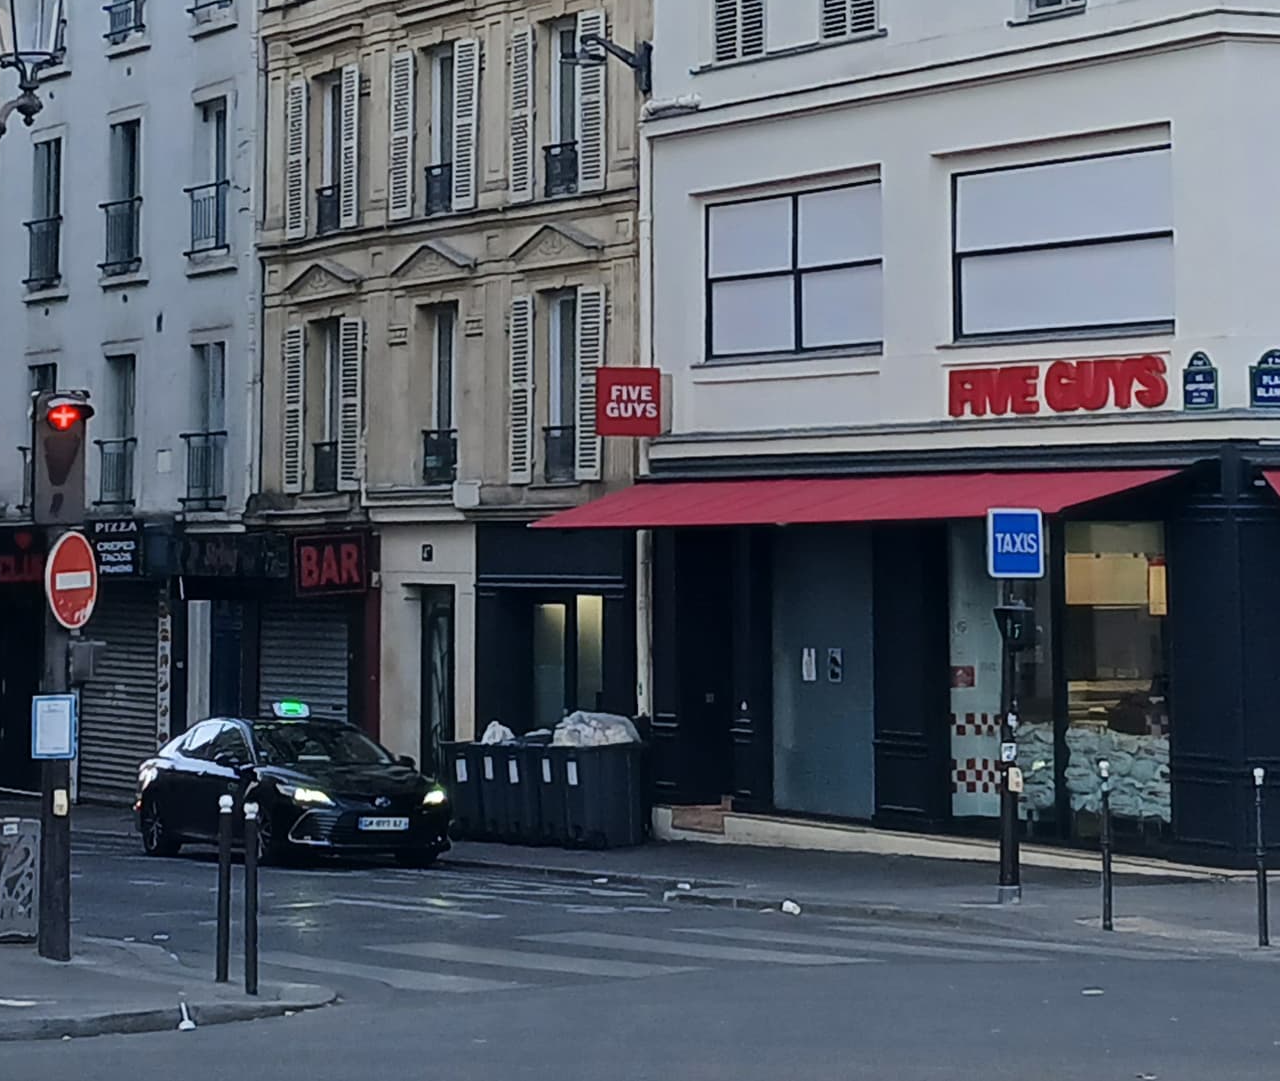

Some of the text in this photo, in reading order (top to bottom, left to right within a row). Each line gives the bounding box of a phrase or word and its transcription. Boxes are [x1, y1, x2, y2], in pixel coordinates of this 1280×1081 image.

[609, 384, 653, 402] FIVE
[948, 364, 1039, 417] FIVE
[1042, 353, 1169, 414] GUYS
[605, 400, 658, 418] GUYS
[95, 521, 137, 533] PIZZA
[995, 532, 1038, 554] TAXIS
[299, 542, 361, 588] BAR
